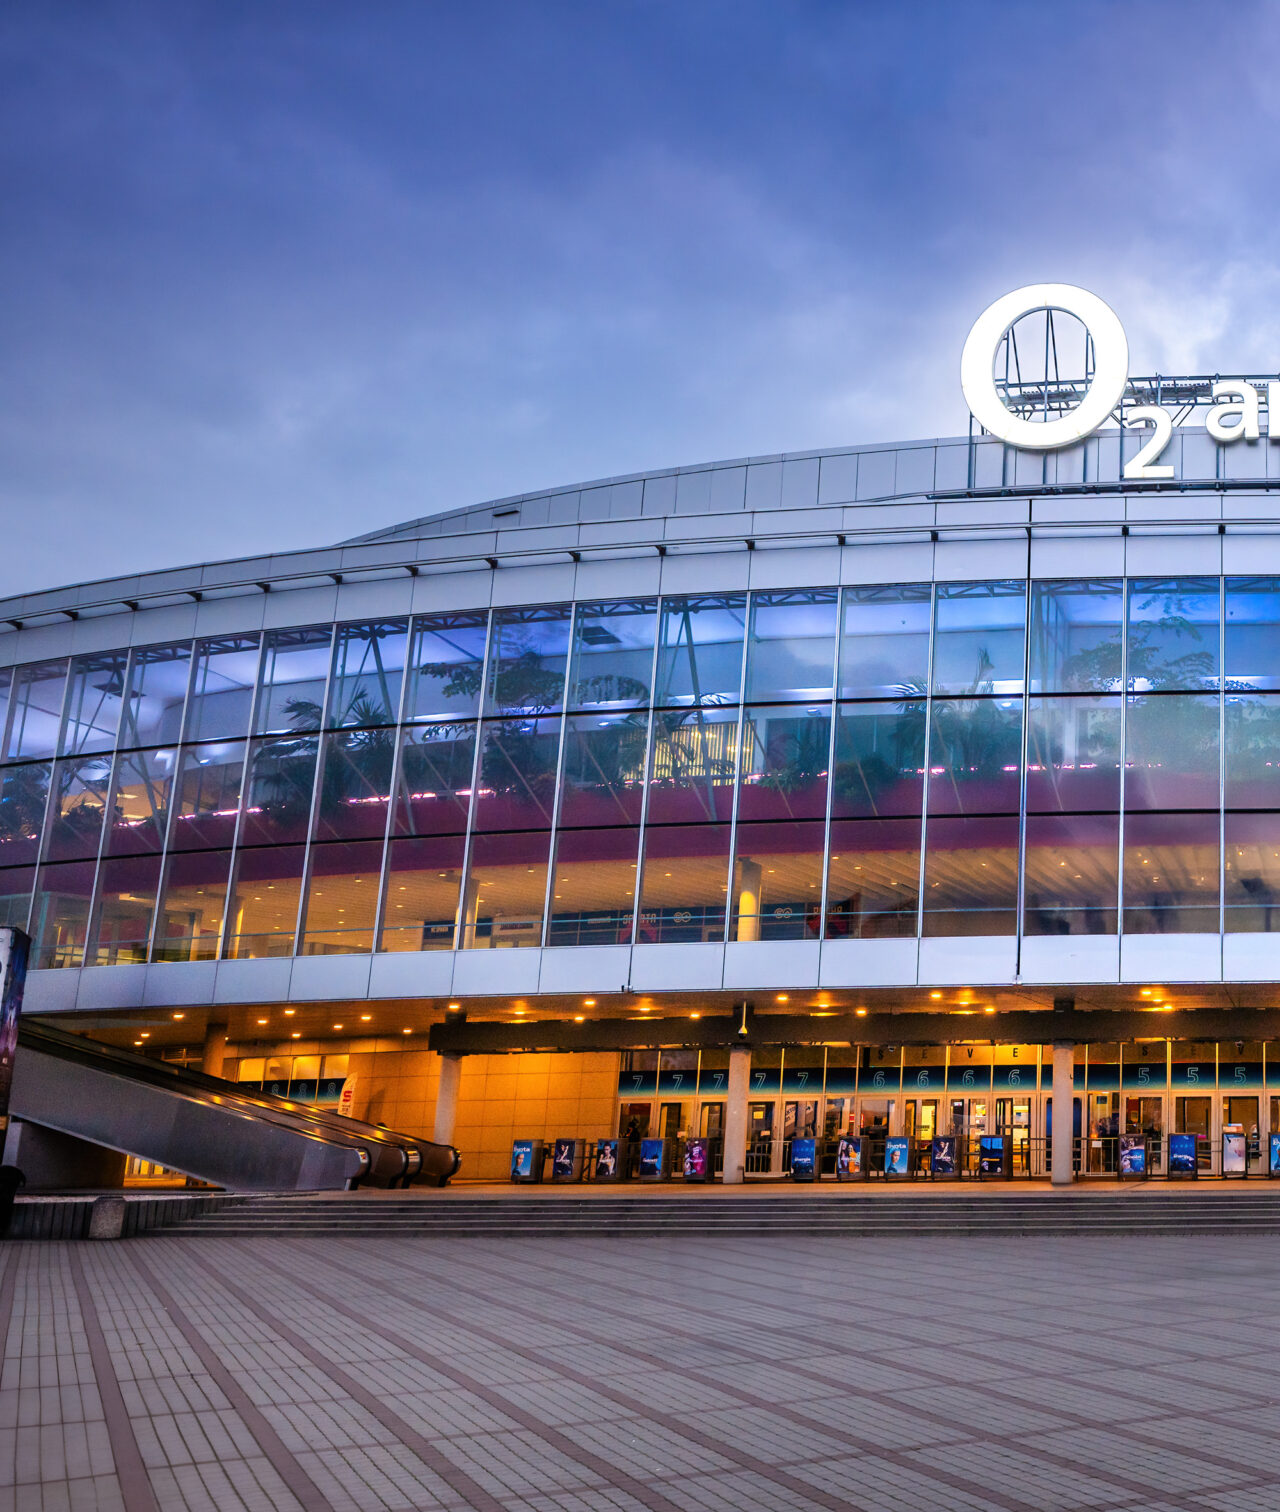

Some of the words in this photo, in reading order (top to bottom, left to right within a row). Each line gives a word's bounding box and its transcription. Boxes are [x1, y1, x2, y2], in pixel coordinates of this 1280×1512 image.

[632, 1074, 644, 1092] 7
[672, 1074, 684, 1091] 7
[713, 1073, 725, 1090] 7
[755, 1072, 767, 1089] 7
[797, 1072, 809, 1089] 7
[873, 1071, 885, 1089] 6
[917, 1070, 929, 1088] 6
[962, 1069, 975, 1088] 6
[1008, 1069, 1021, 1087] 6
[1138, 1067, 1150, 1085] 5
[1187, 1067, 1199, 1084] 5
[1235, 1066, 1247, 1084] 5
[342, 1090, 353, 1102] S
